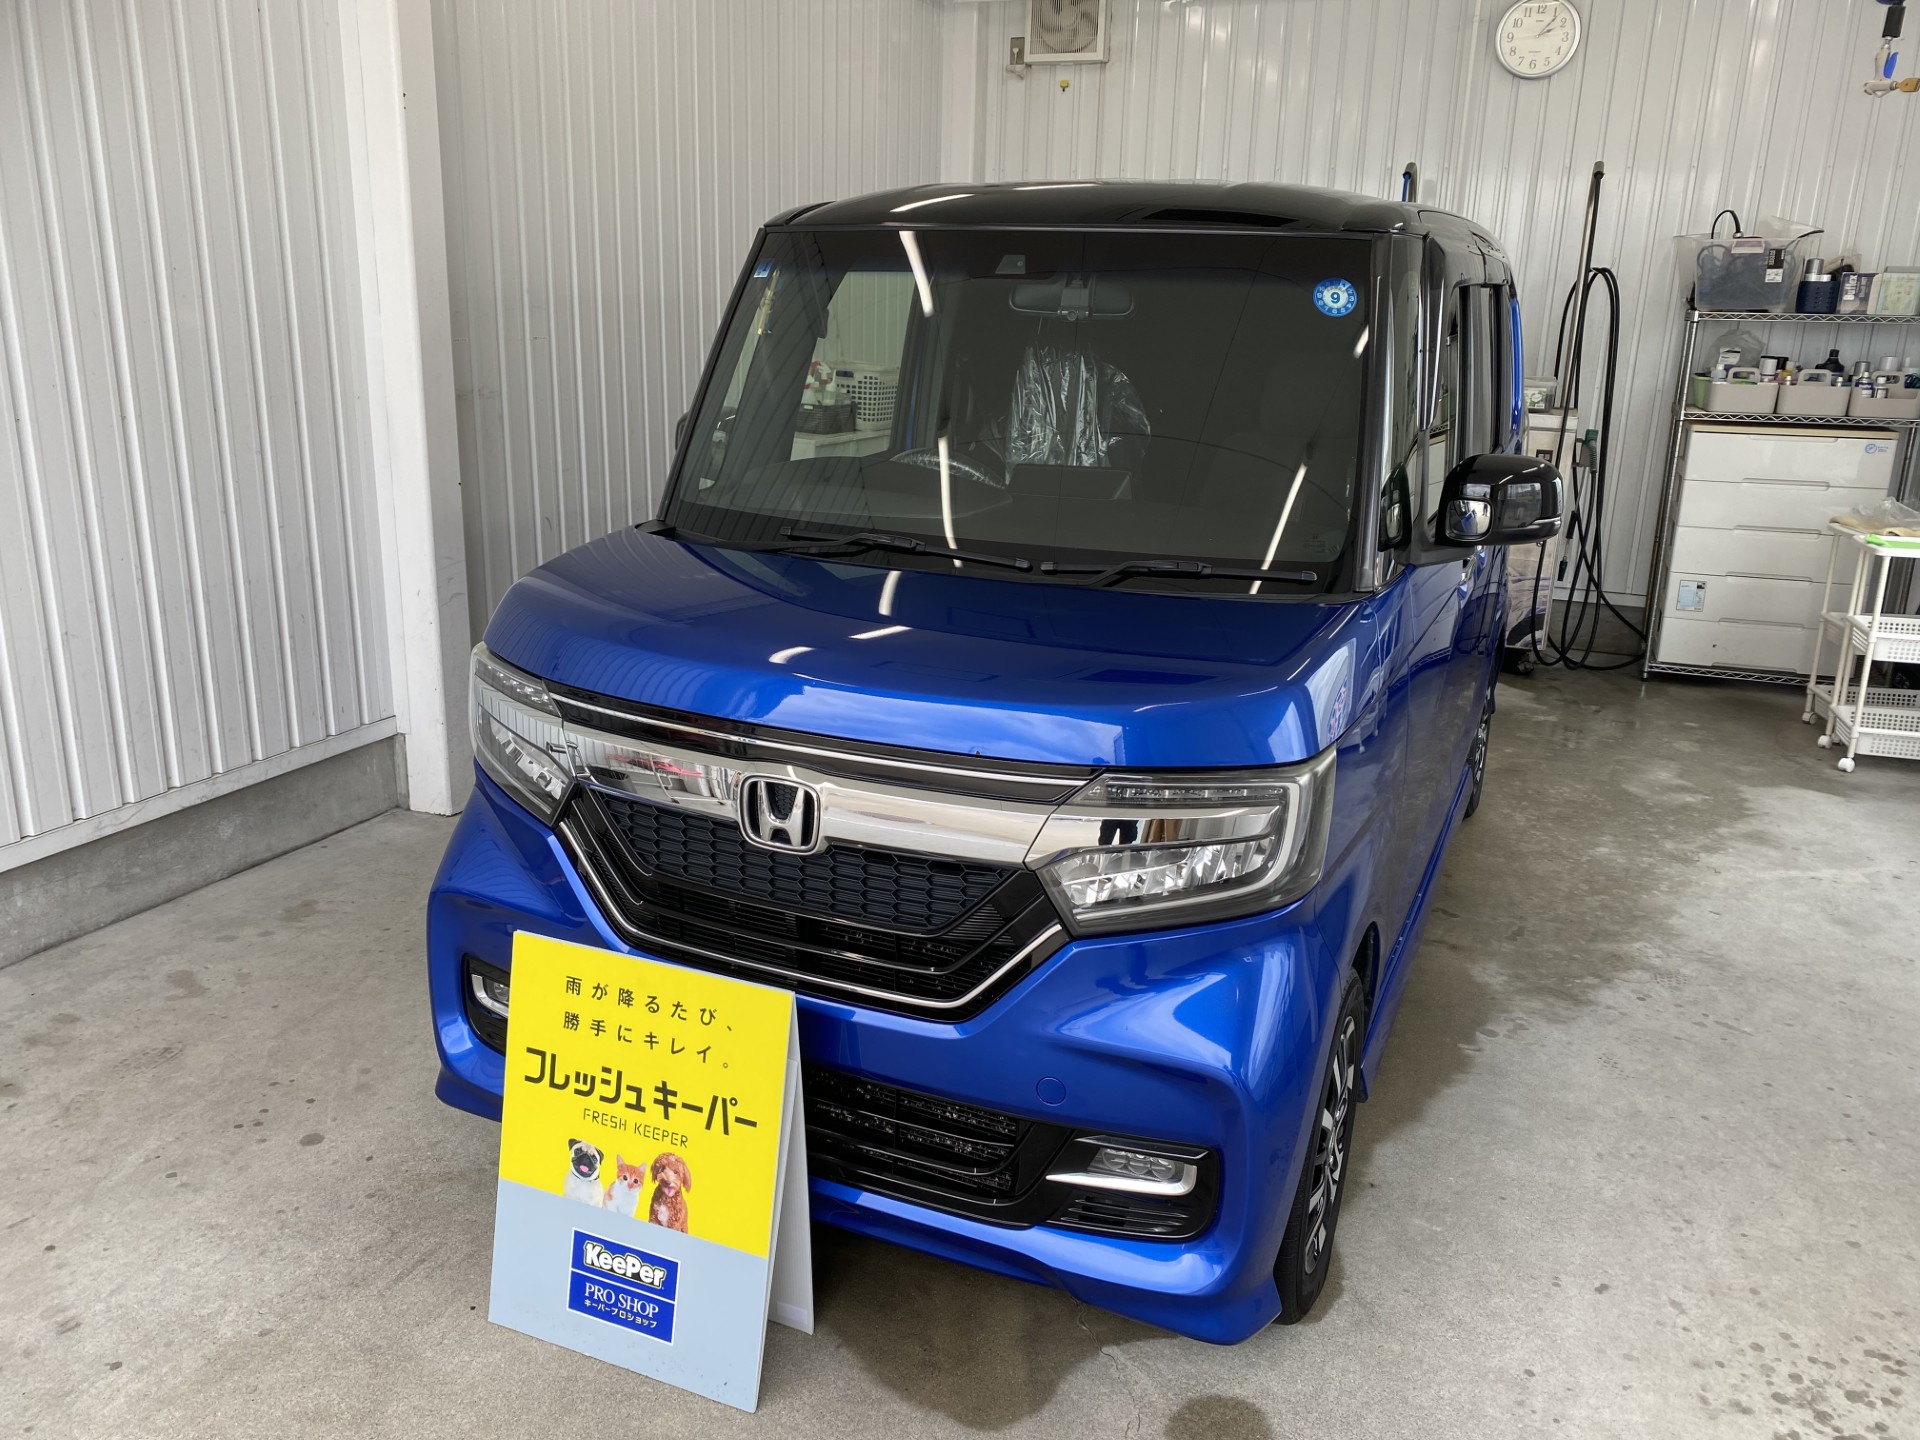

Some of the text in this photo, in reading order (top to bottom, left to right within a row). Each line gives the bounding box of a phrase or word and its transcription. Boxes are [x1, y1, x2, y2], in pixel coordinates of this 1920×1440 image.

[1524, 7, 1532, 17] 11
[1536, 4, 1547, 14] 12
[1553, 7, 1558, 17] 1
[1513, 18, 1523, 28] 10
[1560, 17, 1567, 28] 2
[1507, 32, 1514, 43] 9
[1561, 32, 1569, 42] 3
[1509, 46, 1516, 56] 8
[1555, 46, 1561, 56] 4
[1518, 56, 1525, 66] 7
[1529, 60, 1536, 69] 6
[1544, 57, 1551, 66] 5
[1331, 292, 1340, 304] 9
[565, 975, 732, 1031] 雨が降るたび、
[563, 1011, 729, 1069] 勝手にキレイ。
[524, 1046, 758, 1136] フレッシュキーパー
[583, 1108, 689, 1149] FRESH KEEPER
[583, 1240, 667, 1290] KeePer
[584, 1282, 659, 1318] PRO SHOP
[584, 1299, 657, 1328] キーパープロショップ
